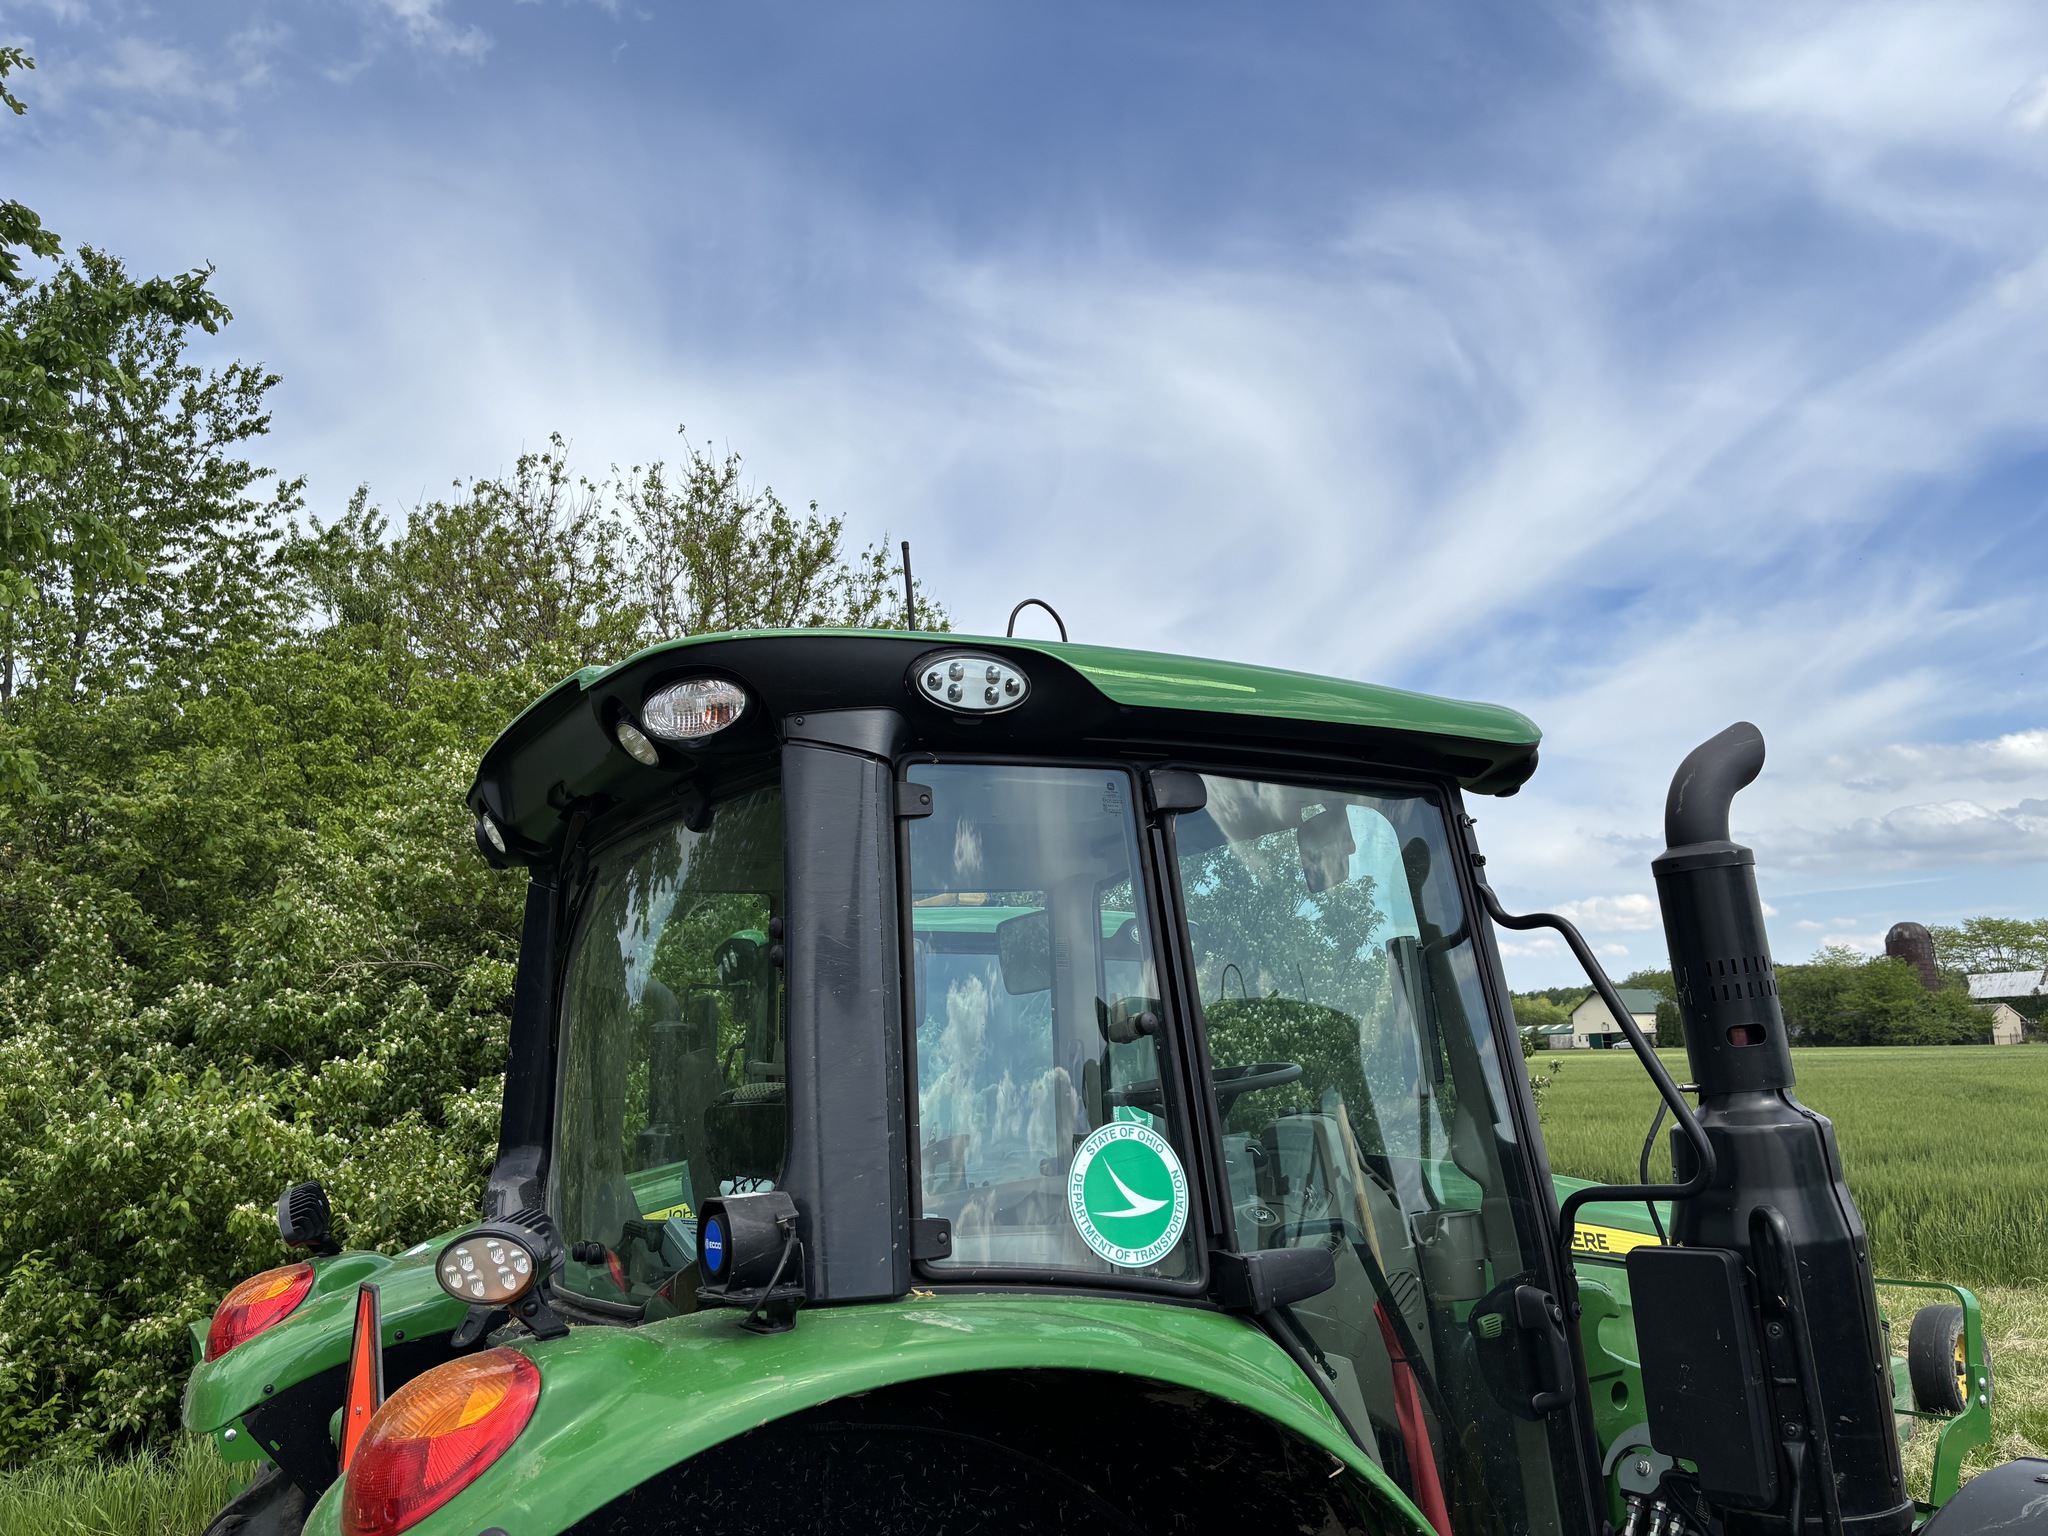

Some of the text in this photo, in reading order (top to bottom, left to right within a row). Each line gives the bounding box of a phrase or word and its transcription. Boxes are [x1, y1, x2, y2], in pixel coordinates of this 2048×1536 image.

[1086, 1127, 1164, 1156] STATE OF OHIO
[1073, 1169, 1185, 1262] DEPARTMENT OF TRANSPORTATION
